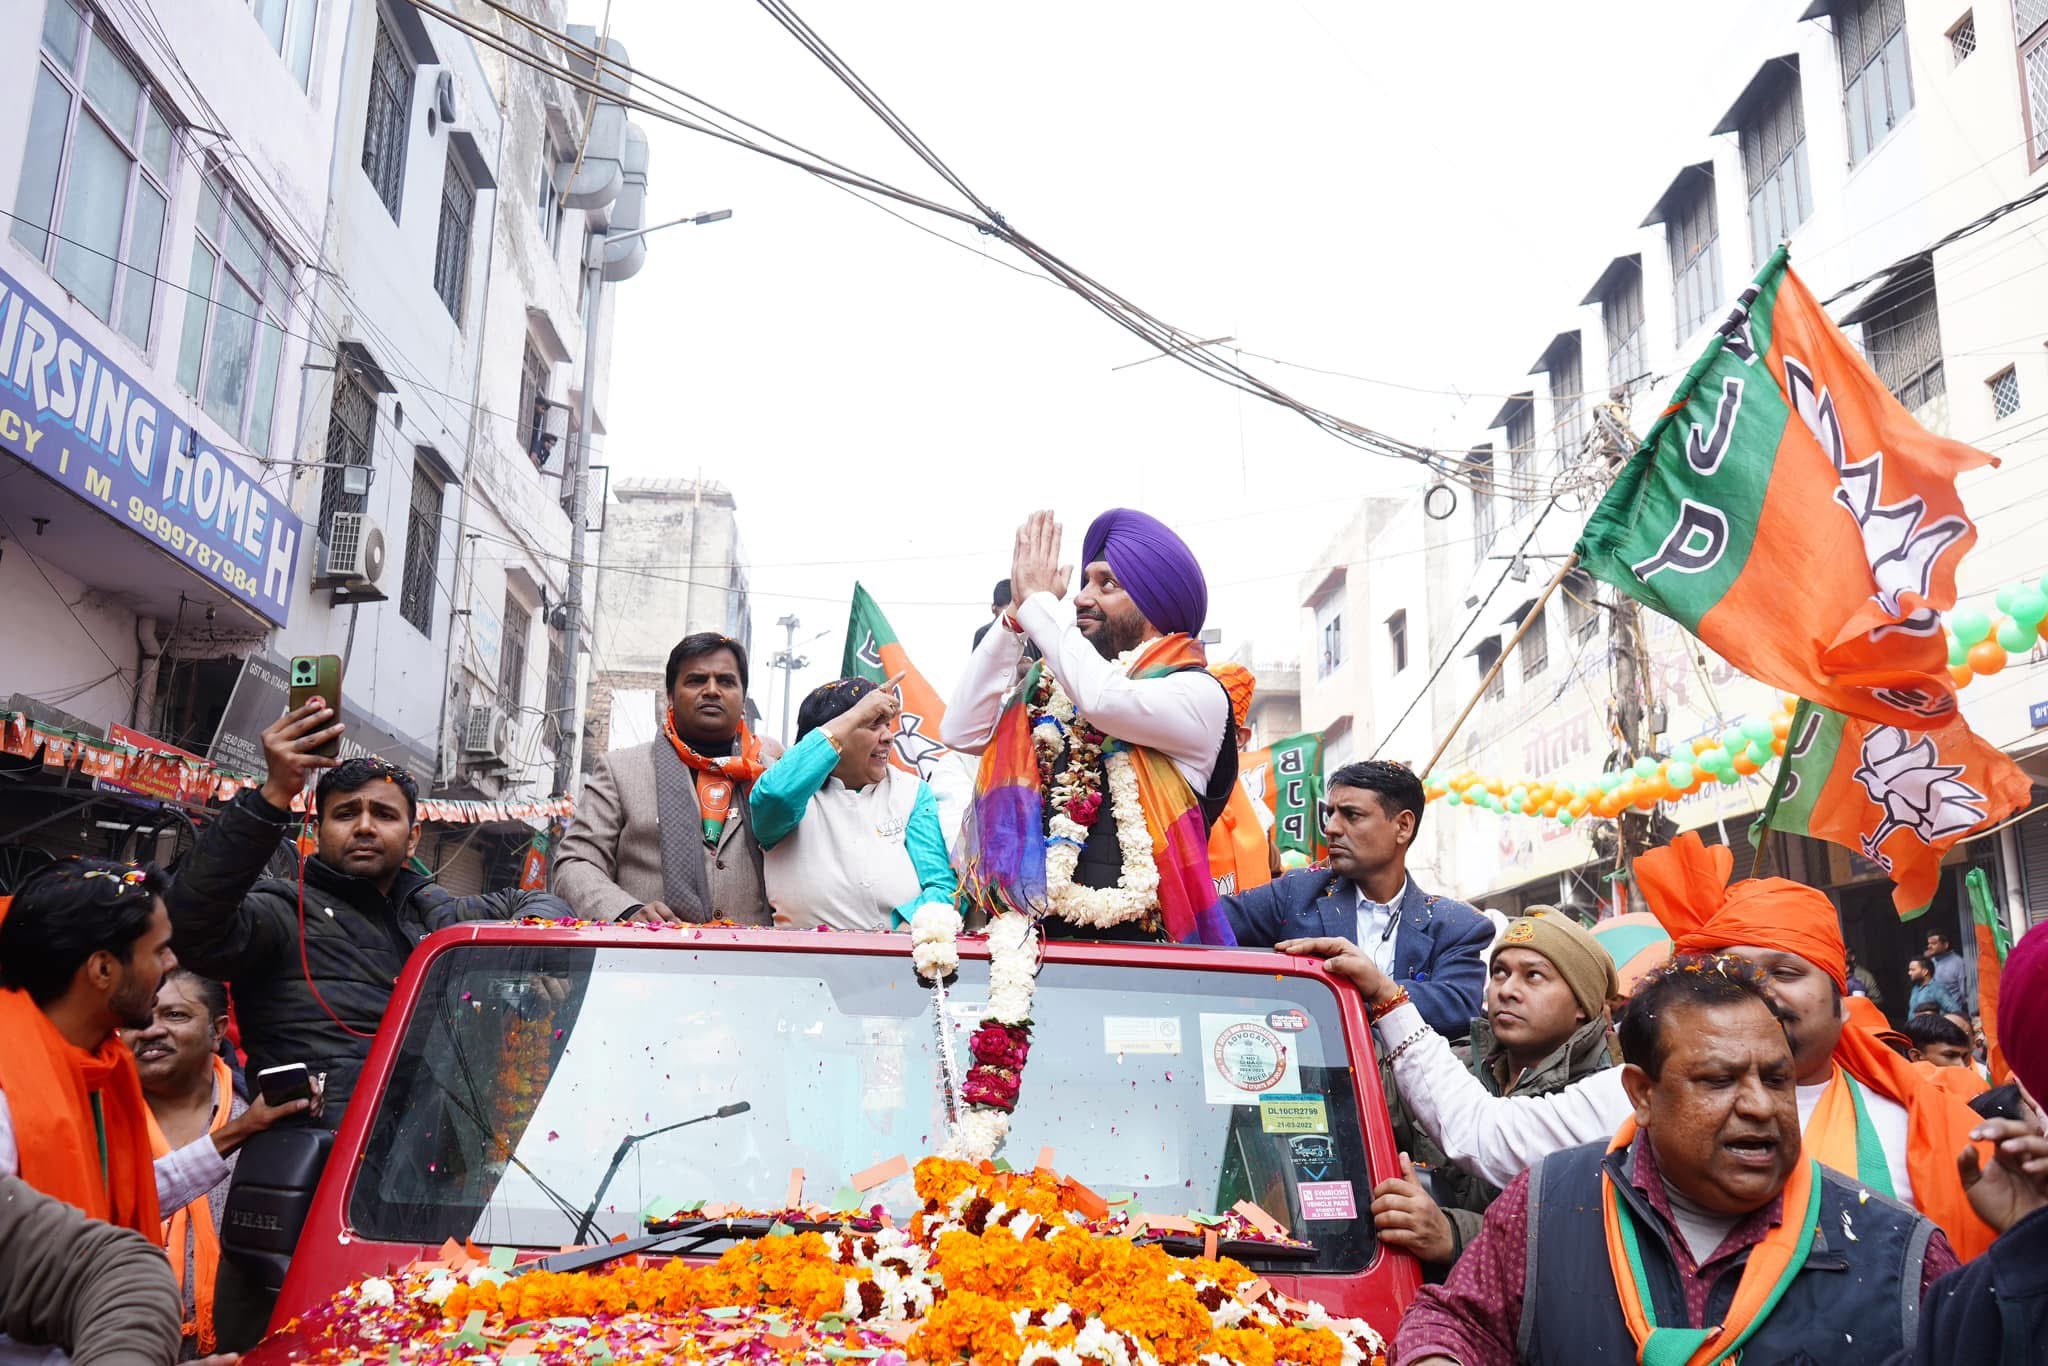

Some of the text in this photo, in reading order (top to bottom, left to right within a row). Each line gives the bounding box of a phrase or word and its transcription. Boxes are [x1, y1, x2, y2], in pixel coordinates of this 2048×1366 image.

[163, 425, 268, 559] HOME
[264, 518, 295, 607] H
[85, 465, 118, 508] M.
[128, 496, 257, 598] 9999787984
[249, 663, 262, 677] GST
[1227, 1031, 1271, 1048] ADVOCATE
[231, 1209, 283, 1231] THAR
